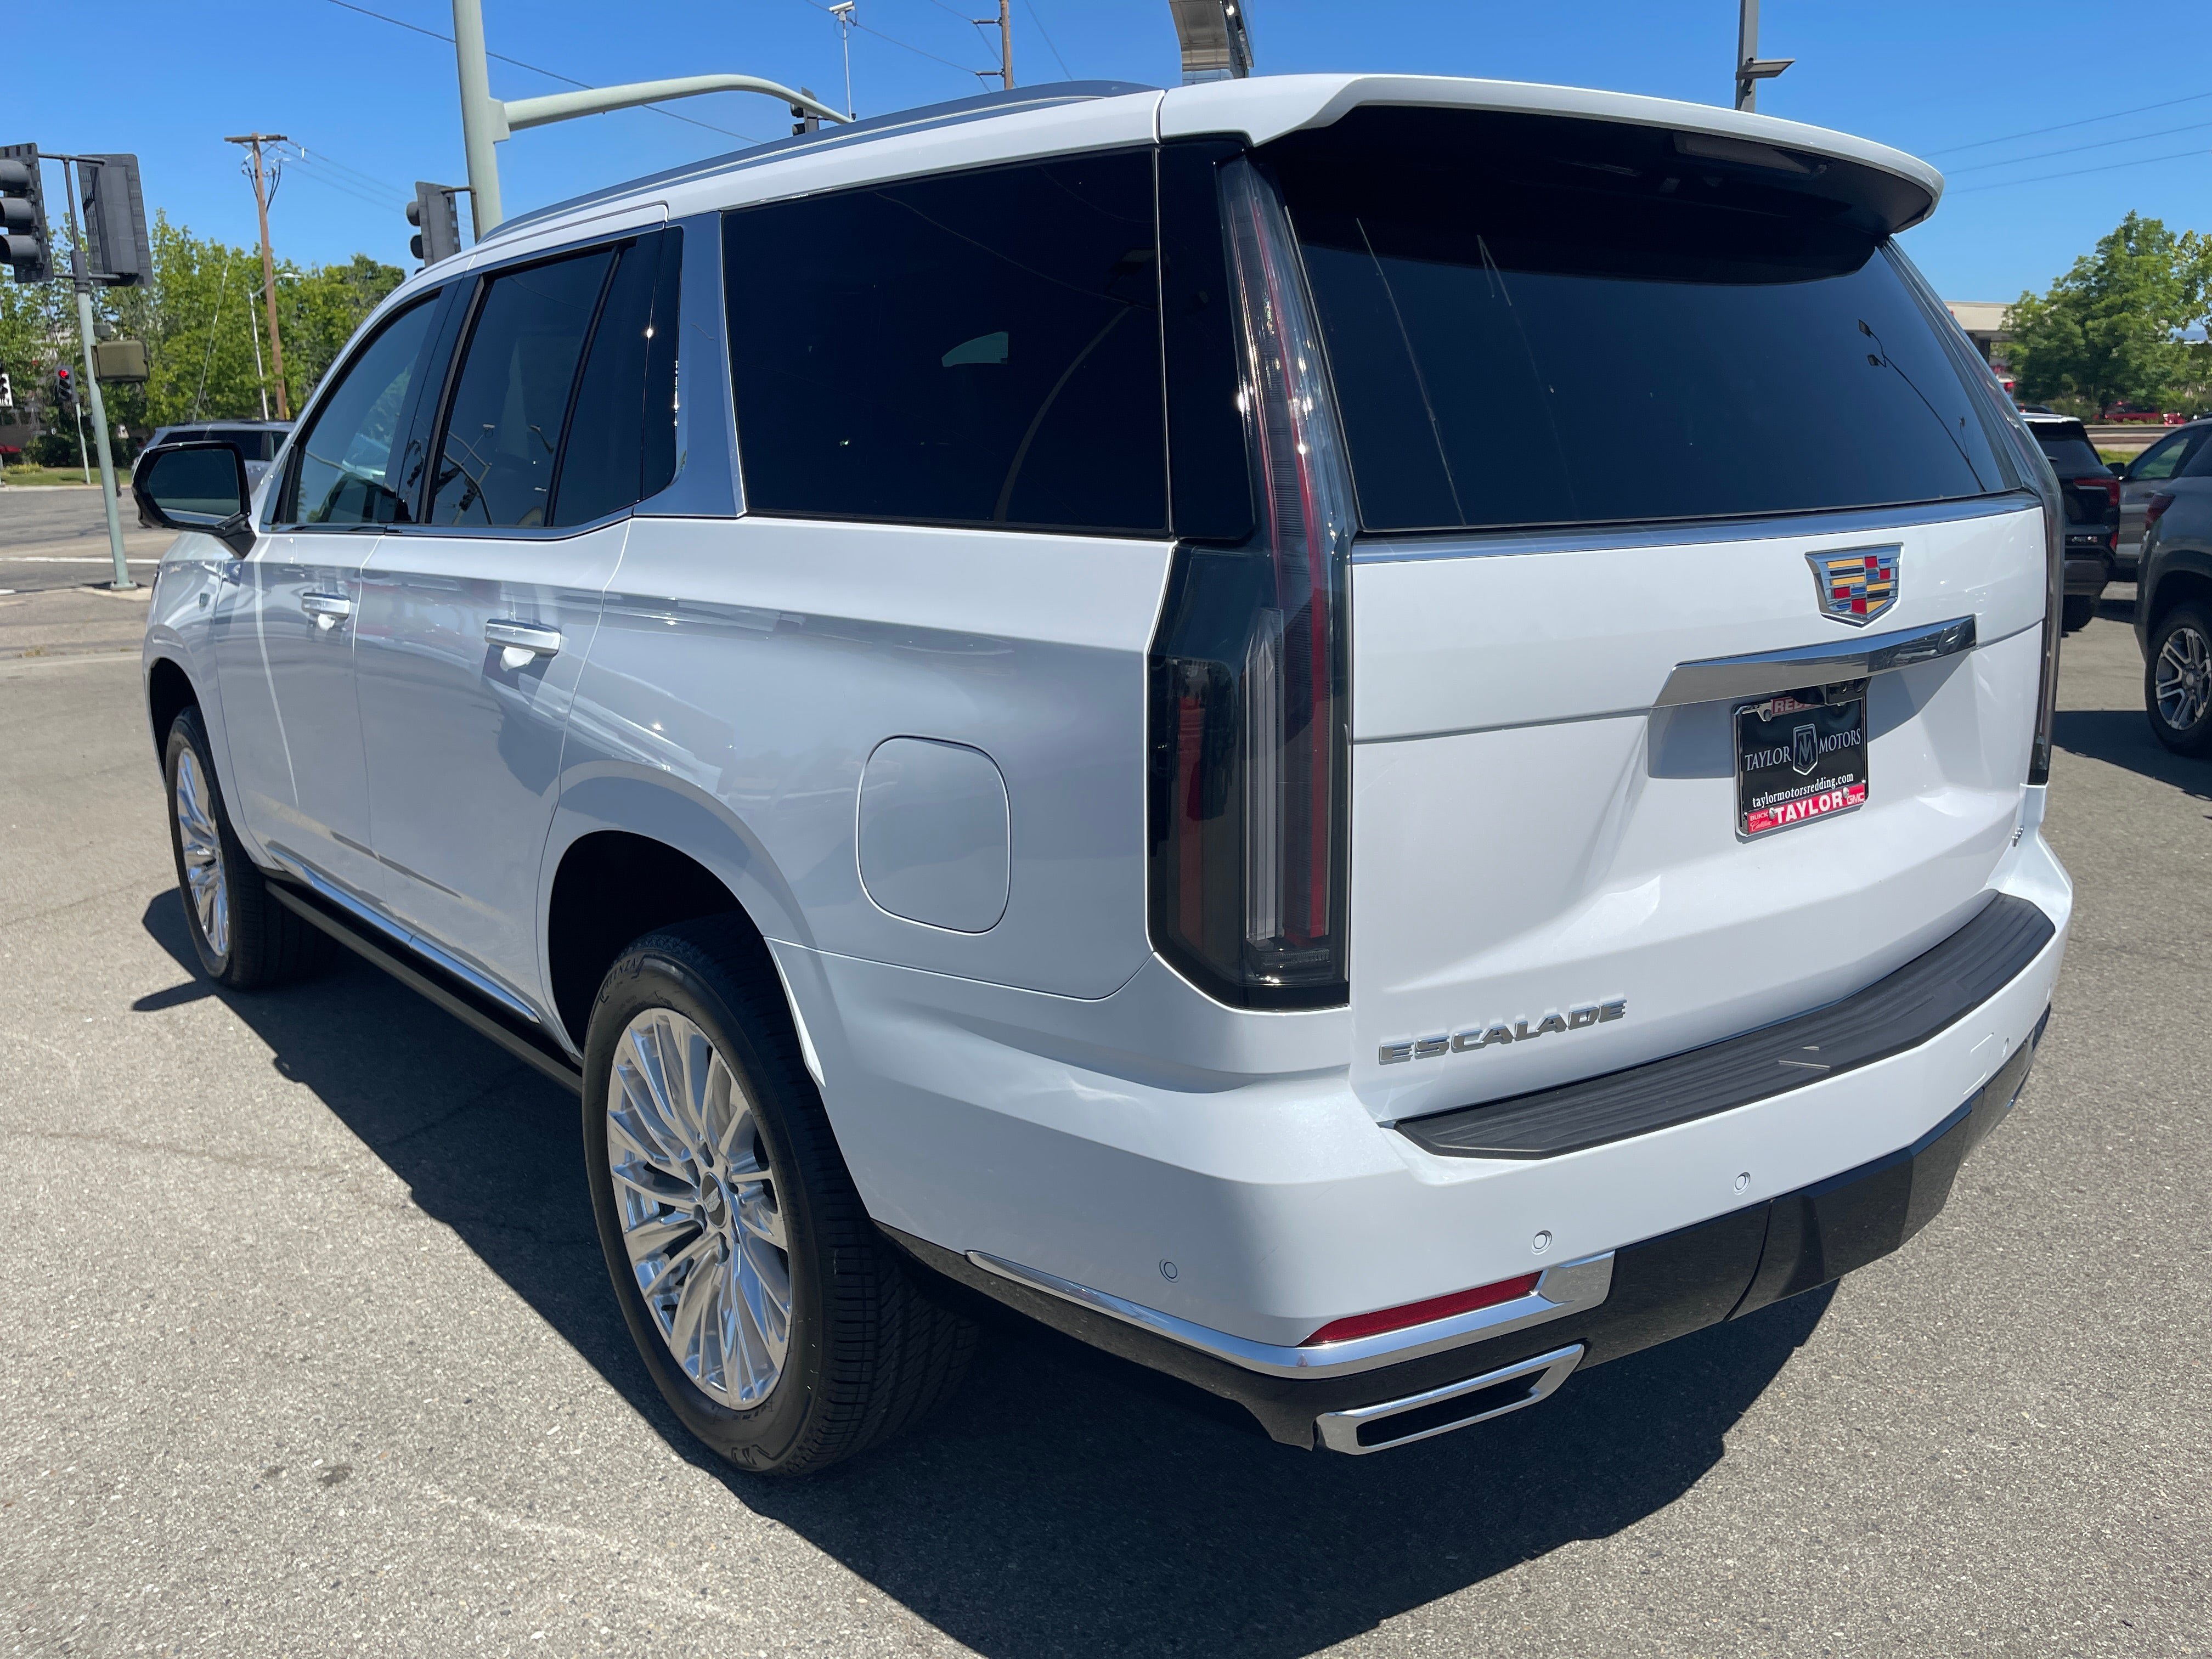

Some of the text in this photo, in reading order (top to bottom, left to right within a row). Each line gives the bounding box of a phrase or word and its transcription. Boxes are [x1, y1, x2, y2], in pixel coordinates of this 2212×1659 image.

[1745, 746, 1792, 771] TAYLOR
[1818, 728, 1861, 754] MOTORS
[1750, 791, 1865, 824] BUICK TAYLOR GMC
[1753, 773, 1854, 808] taylormotorsredding.com
[1379, 998, 1628, 1065] ESCALADE
